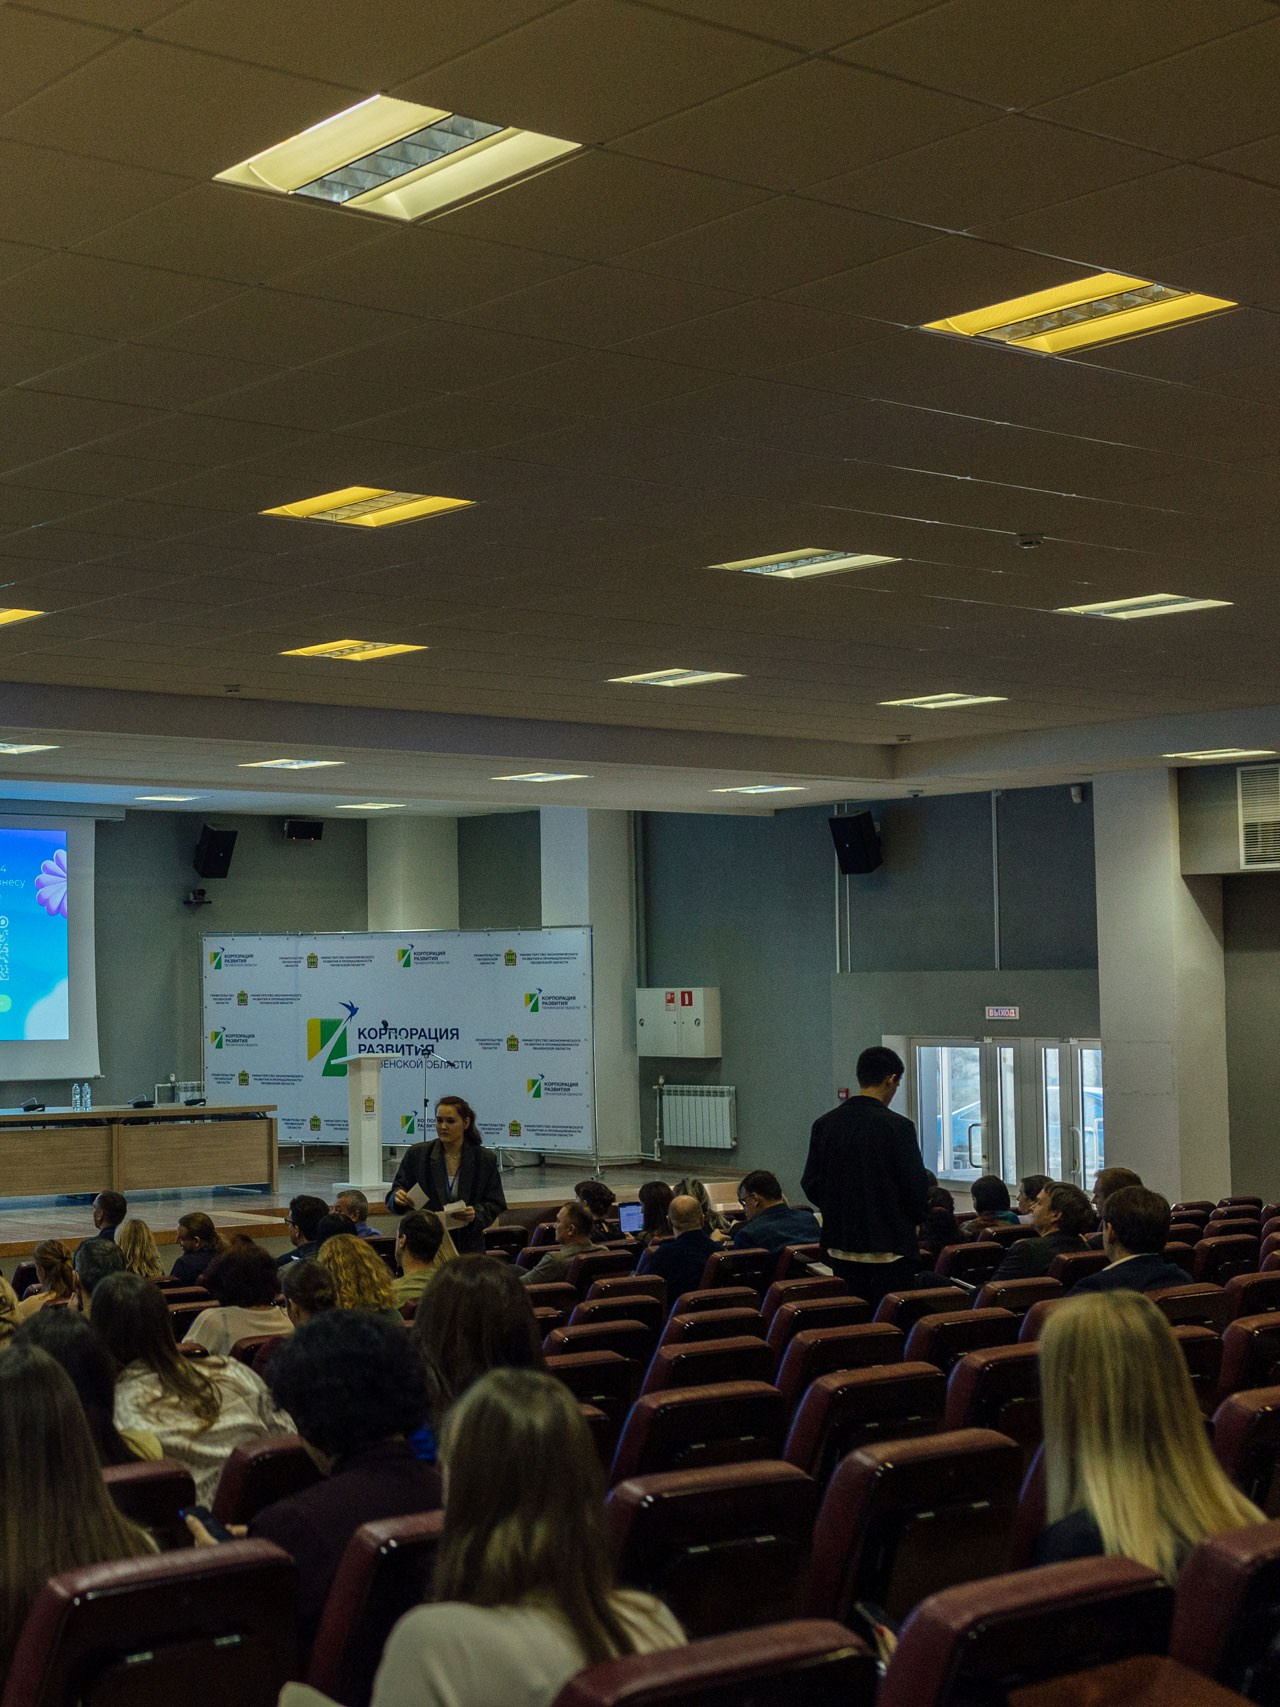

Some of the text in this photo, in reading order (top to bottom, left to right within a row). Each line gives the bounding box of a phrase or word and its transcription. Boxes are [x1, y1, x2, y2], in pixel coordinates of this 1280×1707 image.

[989, 1009, 1016, 1017] ВЫХОД
[358, 1027, 459, 1042] КОРПОРАЦИЯ
[358, 1044, 435, 1056] РАЗВИТИЯ
